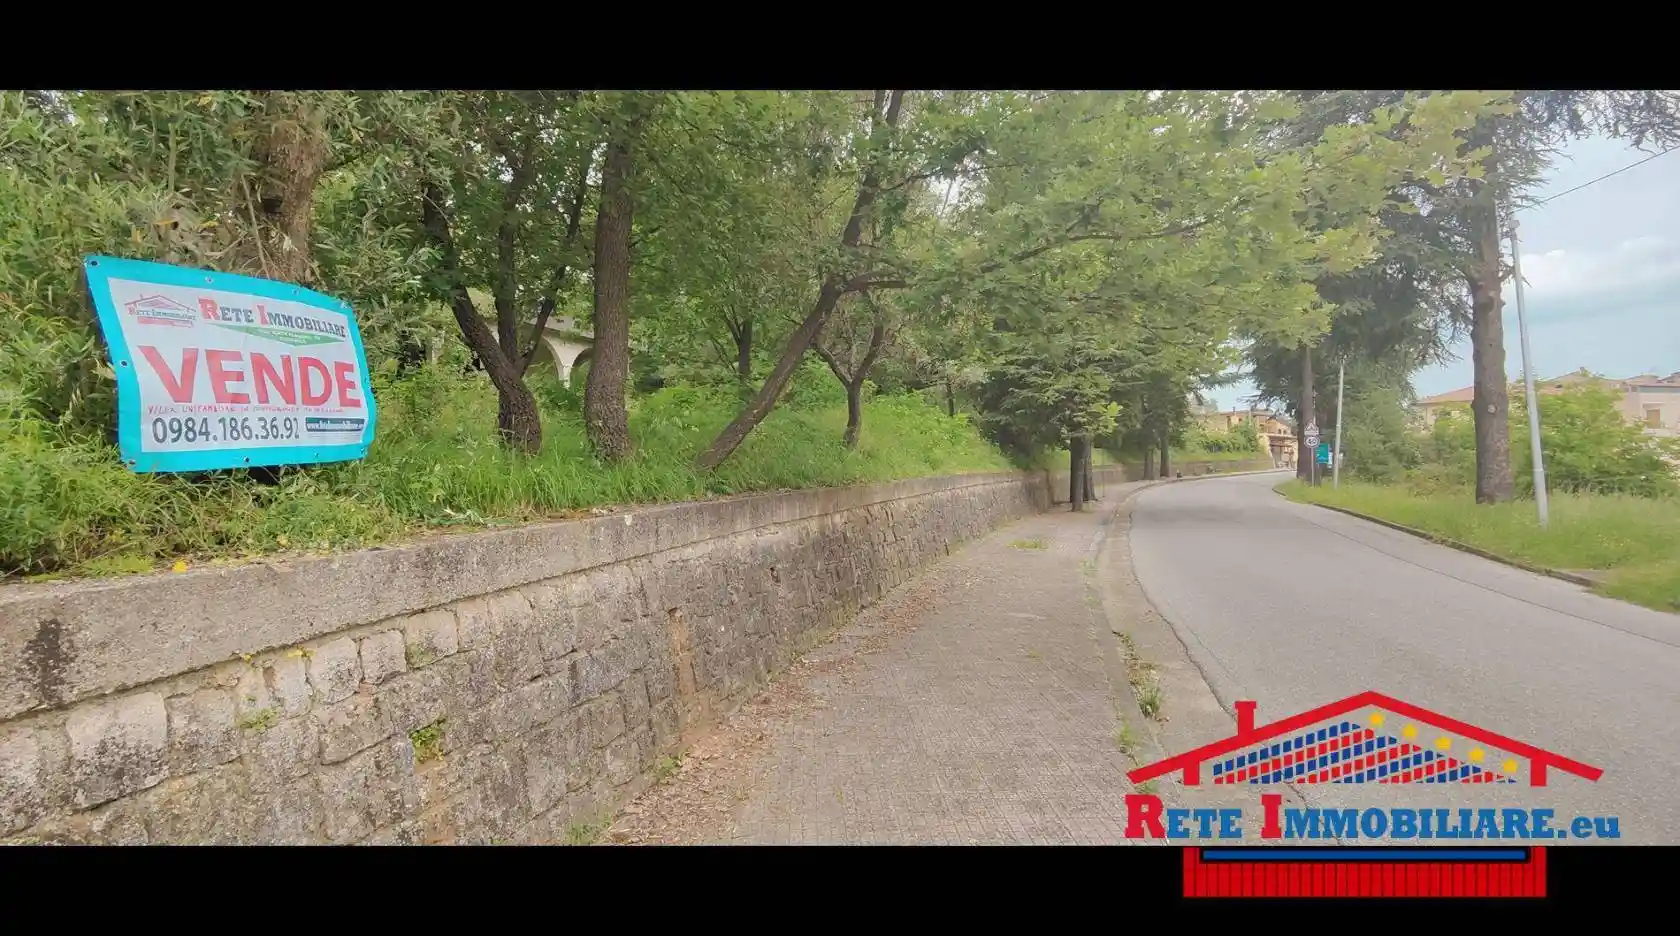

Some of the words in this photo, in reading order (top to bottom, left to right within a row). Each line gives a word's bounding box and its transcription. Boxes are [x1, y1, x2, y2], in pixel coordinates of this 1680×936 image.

[198, 298, 255, 324] RETE
[257, 305, 347, 338] IMMOBILIARE
[139, 346, 362, 408] VENDE
